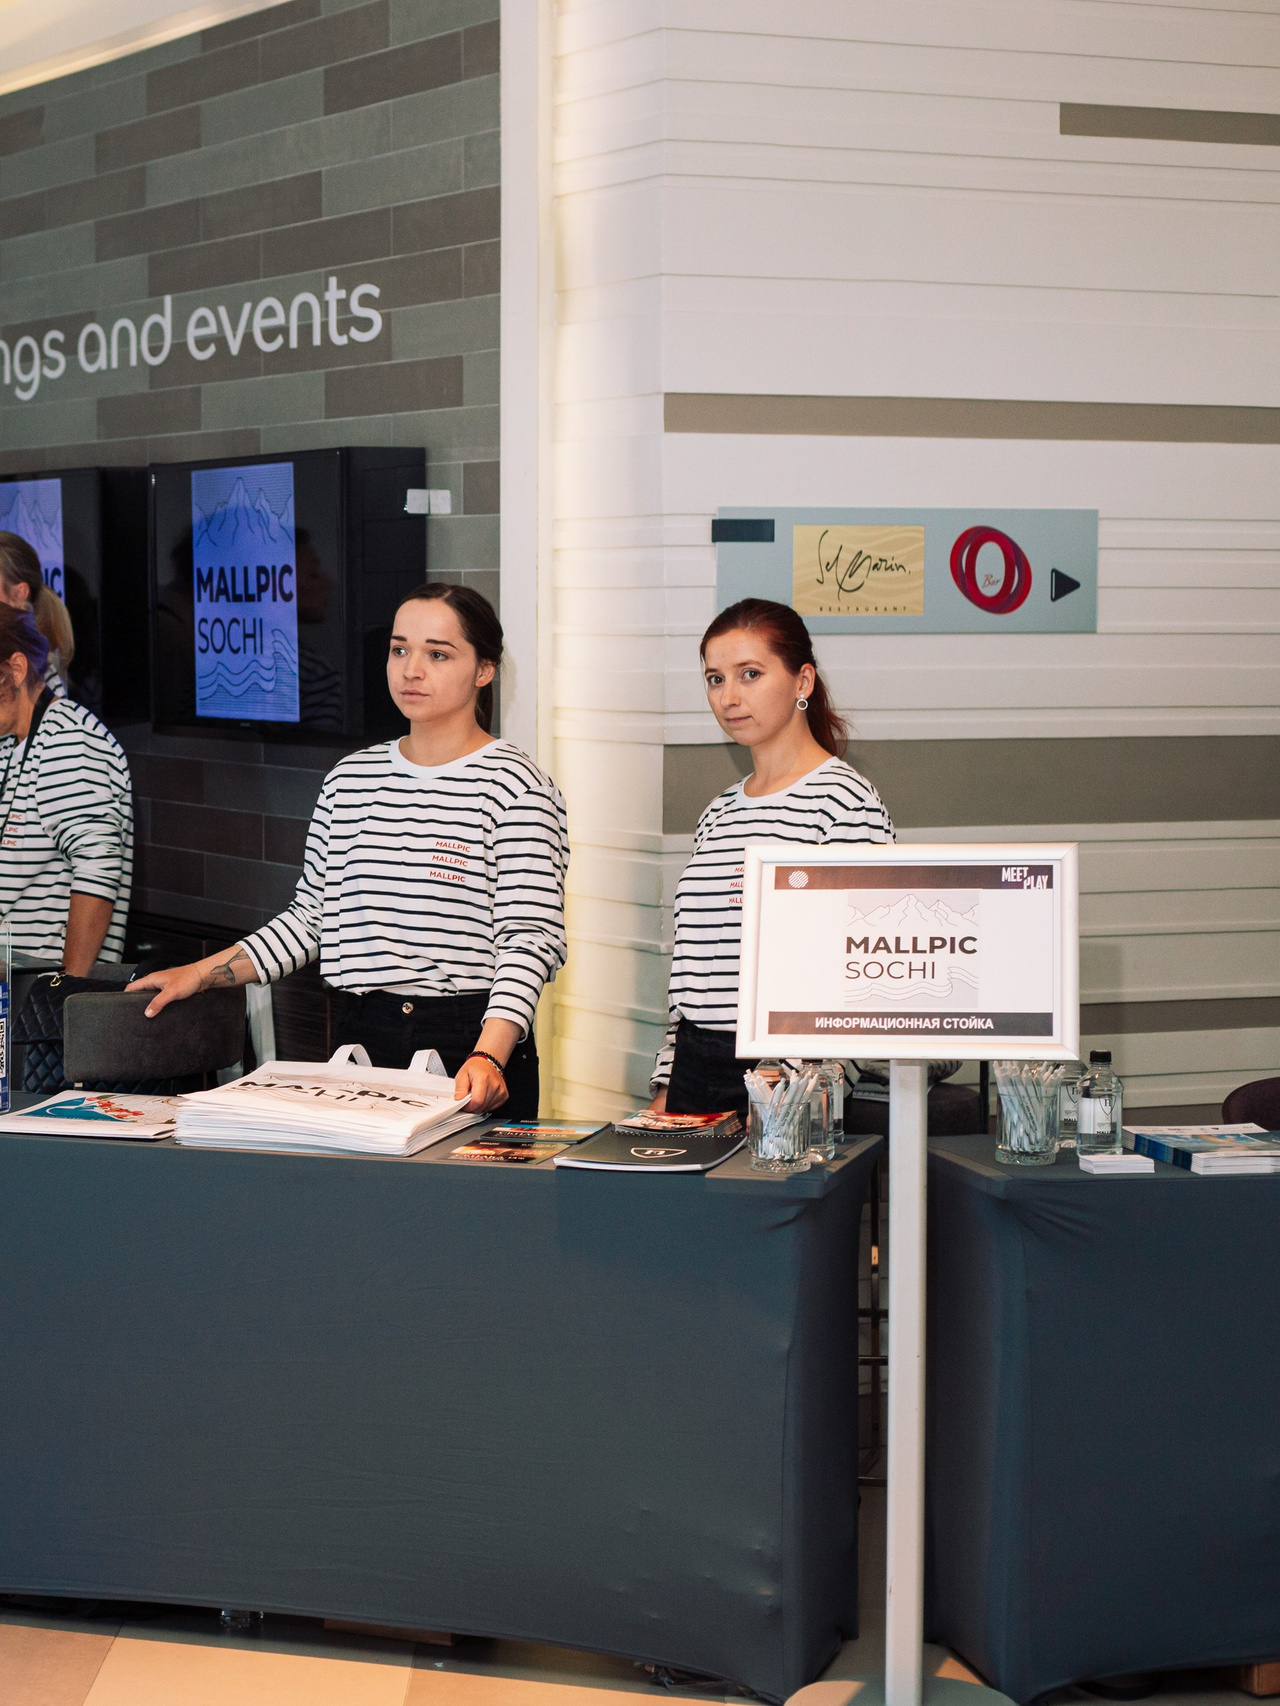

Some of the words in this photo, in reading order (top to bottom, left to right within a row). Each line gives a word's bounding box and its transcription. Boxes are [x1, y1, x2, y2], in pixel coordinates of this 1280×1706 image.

[78, 294, 173, 373] and
[186, 275, 383, 361] events
[195, 564, 295, 604] MALLPIC
[197, 617, 264, 656] SOCHI
[435, 840, 471, 853] MALLPIC
[431, 854, 468, 867] MALLPIC
[429, 870, 466, 883] MALLPIC
[1001, 866, 1029, 882] MEET
[1023, 875, 1049, 889] PLAY
[845, 936, 978, 954] MALLPIC
[845, 960, 936, 979] SOCHI
[815, 1016, 940, 1031] ИНФОРМАЦИОННАЯ
[942, 1015, 994, 1030] СТОЙКА
